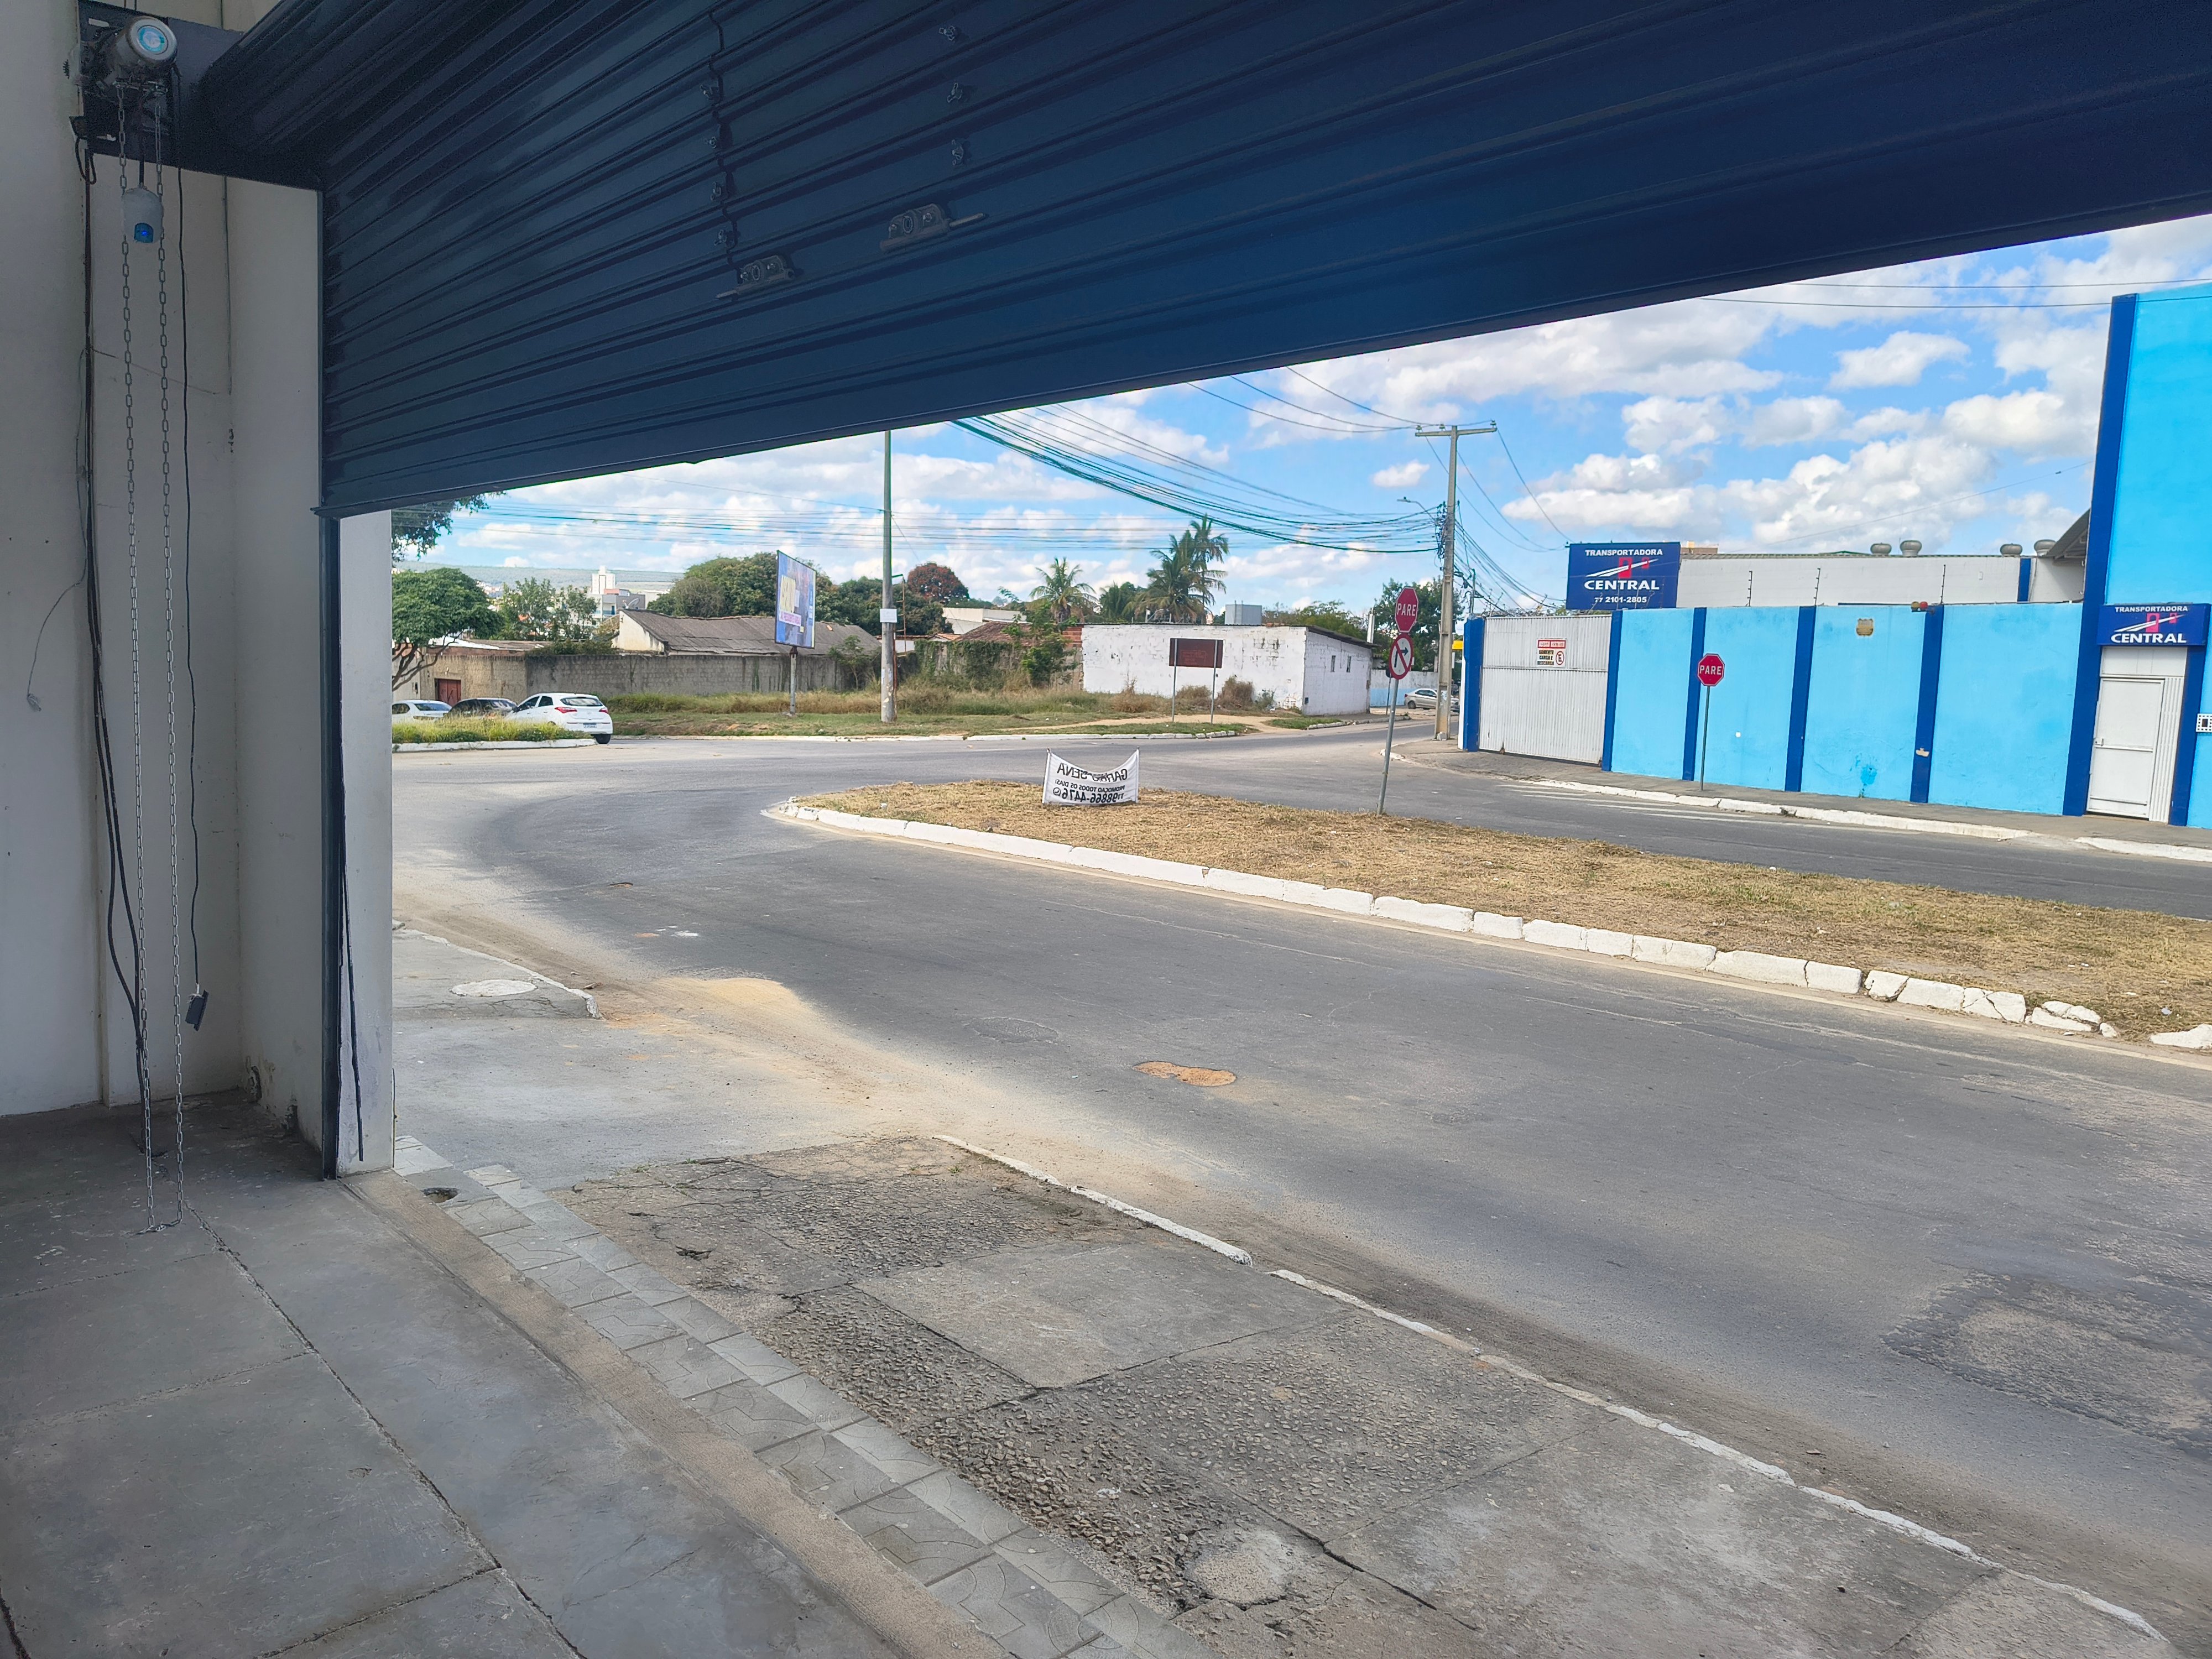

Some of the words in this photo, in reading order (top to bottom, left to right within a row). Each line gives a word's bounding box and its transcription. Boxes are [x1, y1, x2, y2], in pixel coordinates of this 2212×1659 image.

[1584, 580, 1660, 590] CENTRAL
[1397, 603, 1416, 617] PARE
[2111, 633, 2187, 643] CENTRAL
[1699, 665, 1722, 675] PARE
